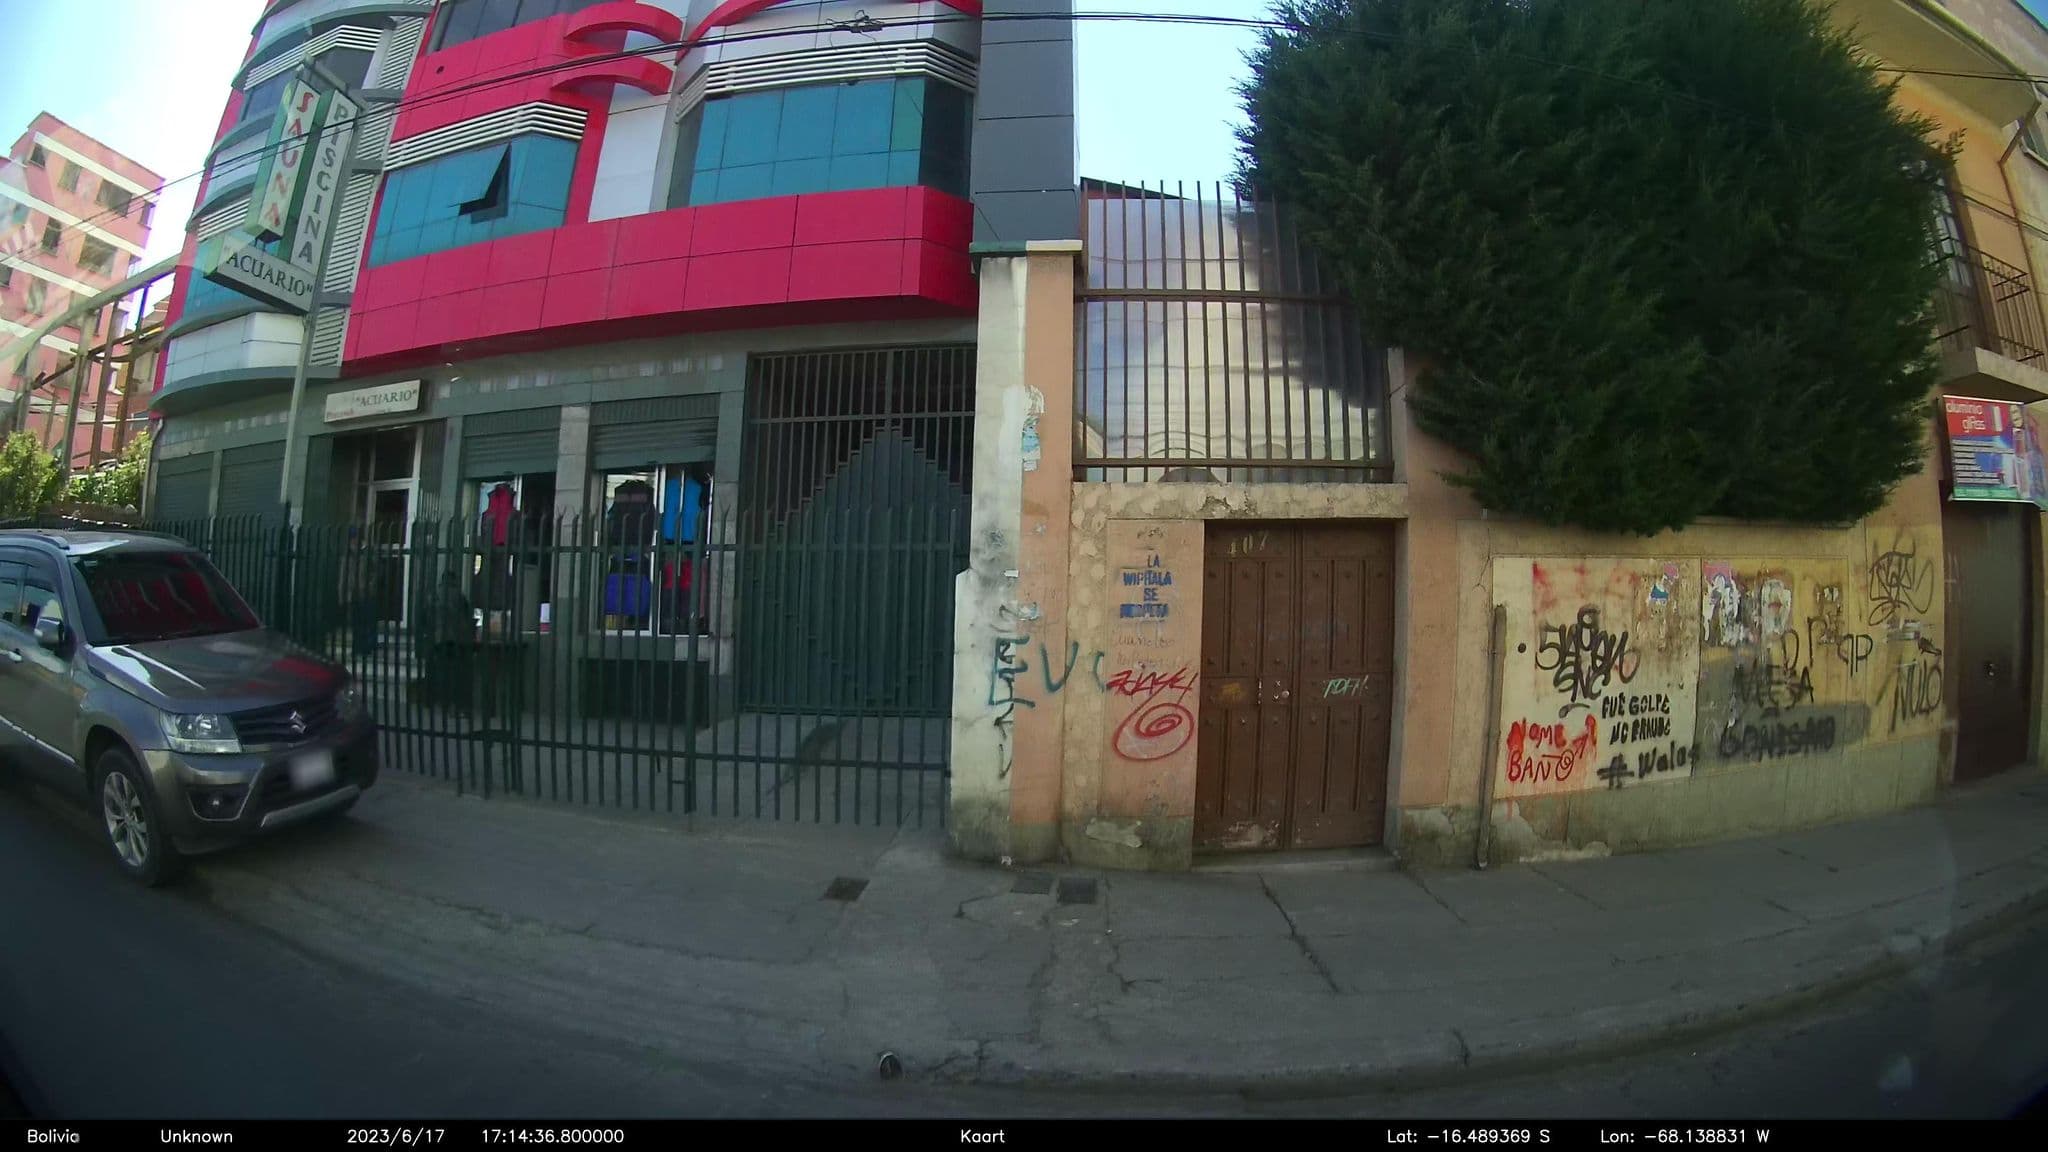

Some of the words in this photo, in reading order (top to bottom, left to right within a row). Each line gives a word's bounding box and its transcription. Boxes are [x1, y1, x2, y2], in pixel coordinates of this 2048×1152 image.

[262, 91, 315, 228] SAUNA
[297, 103, 349, 265] PISCINA
[1147, 554, 1160, 568] LA
[1143, 587, 1159, 601] SE
[1628, 694, 1671, 716] GOLPE
